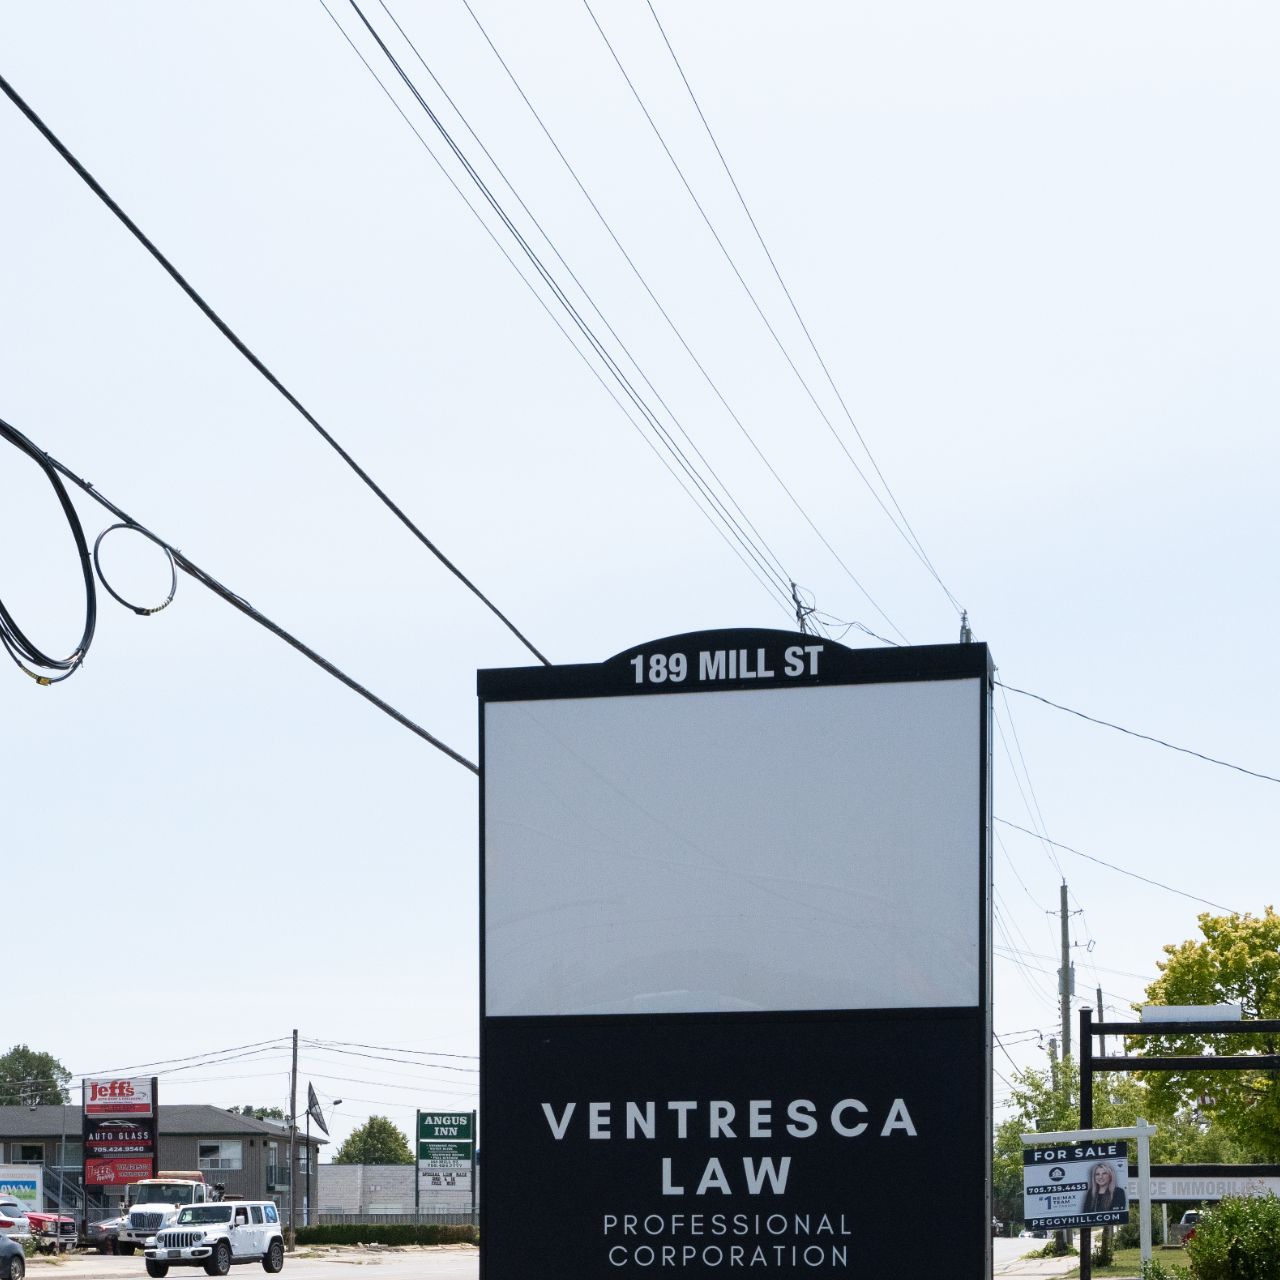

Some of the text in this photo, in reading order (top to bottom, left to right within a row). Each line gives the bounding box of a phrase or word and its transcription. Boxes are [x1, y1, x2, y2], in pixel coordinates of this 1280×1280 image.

[630, 645, 824, 684] 189 MILL ST
[90, 1080, 135, 1101] Jeff's
[424, 1116, 467, 1125] ANGUS
[541, 1098, 918, 1139] VENTRESCA
[88, 1131, 149, 1140] AUTO GLASS
[433, 1127, 458, 1136] INN
[1034, 1145, 1117, 1161] FOR SALE
[662, 1156, 792, 1195] LAW
[1028, 1183, 1087, 1194] 705.739.4455
[603, 1213, 852, 1236] PROFESSIONAL
[1032, 1213, 1120, 1226] PEGGYHILL.COM
[608, 1245, 847, 1267] CORPORATION
